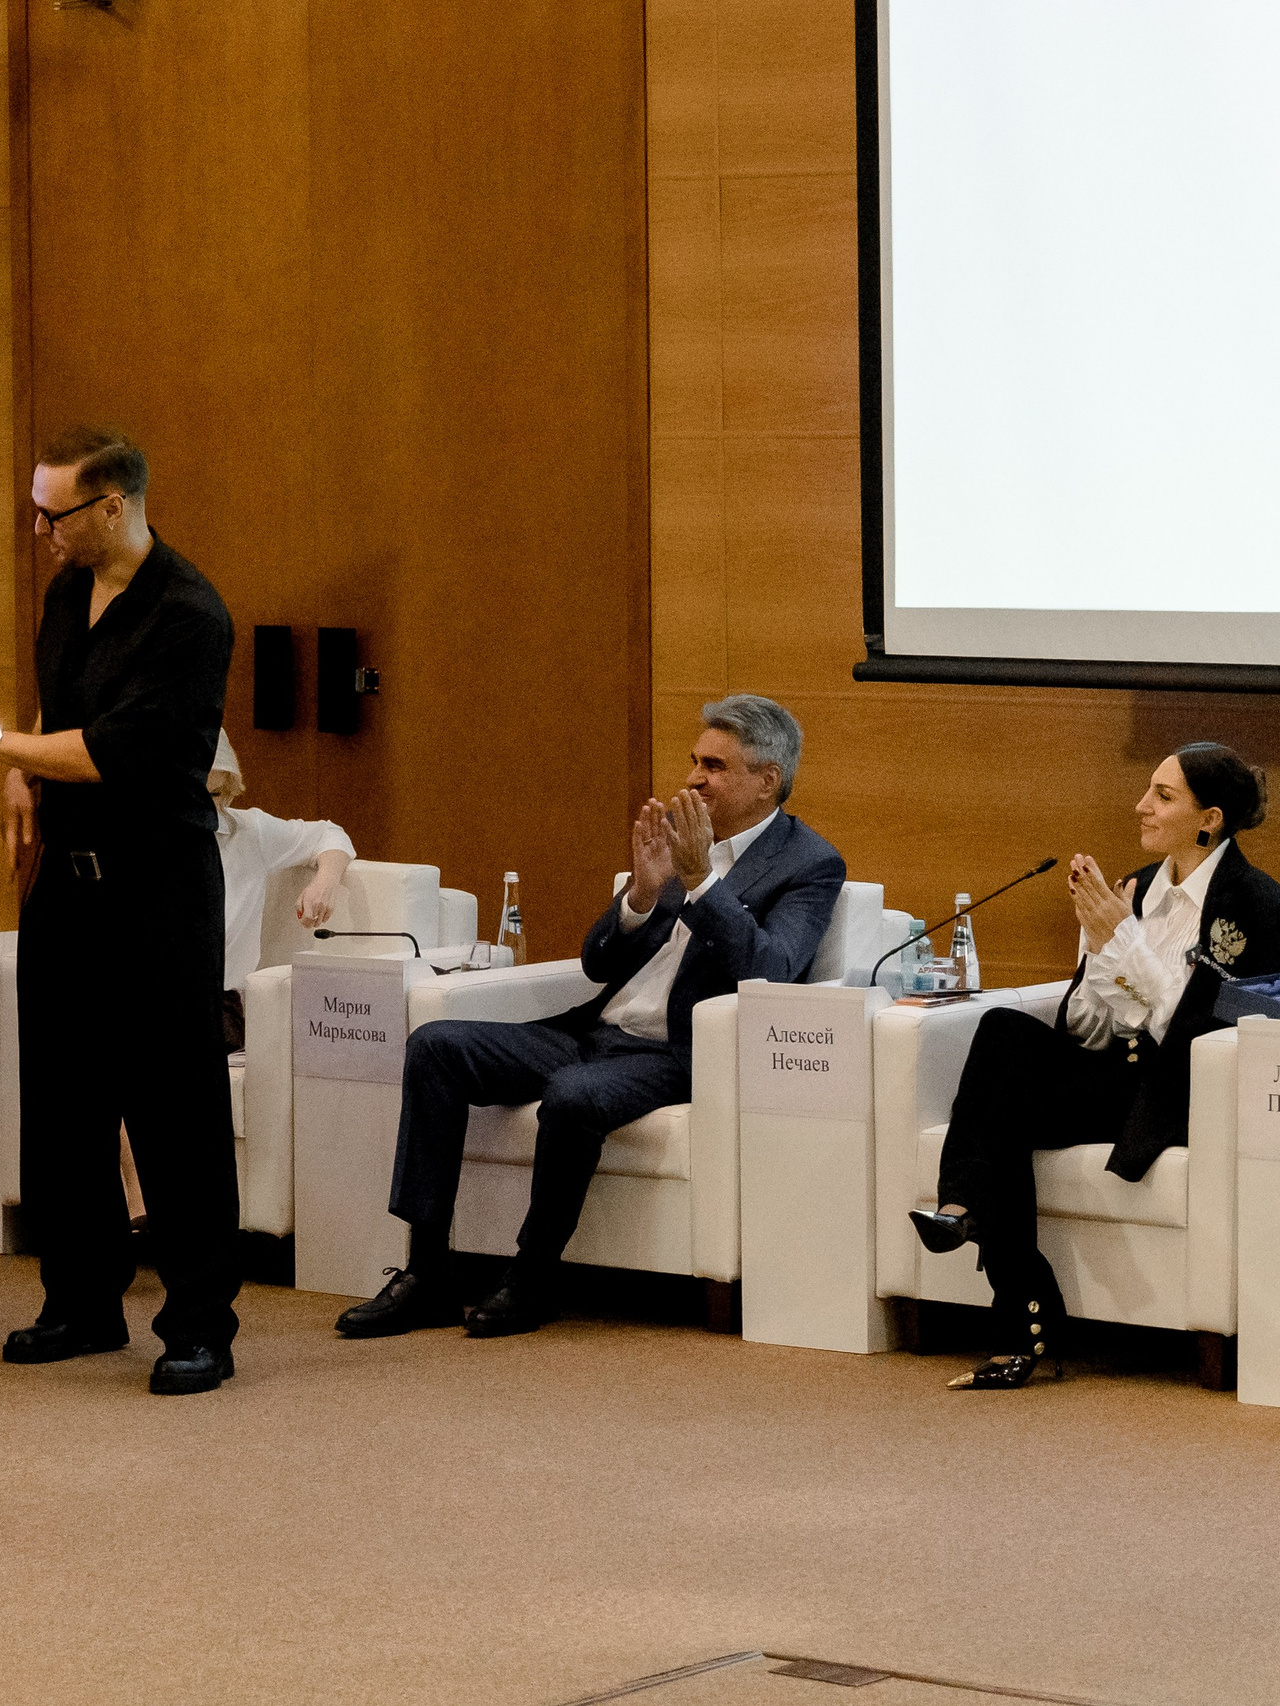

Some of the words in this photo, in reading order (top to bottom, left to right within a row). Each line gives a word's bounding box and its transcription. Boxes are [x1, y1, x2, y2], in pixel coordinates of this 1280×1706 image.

[324, 996, 371, 1018] Мария
[309, 1020, 386, 1042] Марьясова
[766, 1025, 834, 1045] Алексей
[772, 1053, 830, 1072] Нечаев
